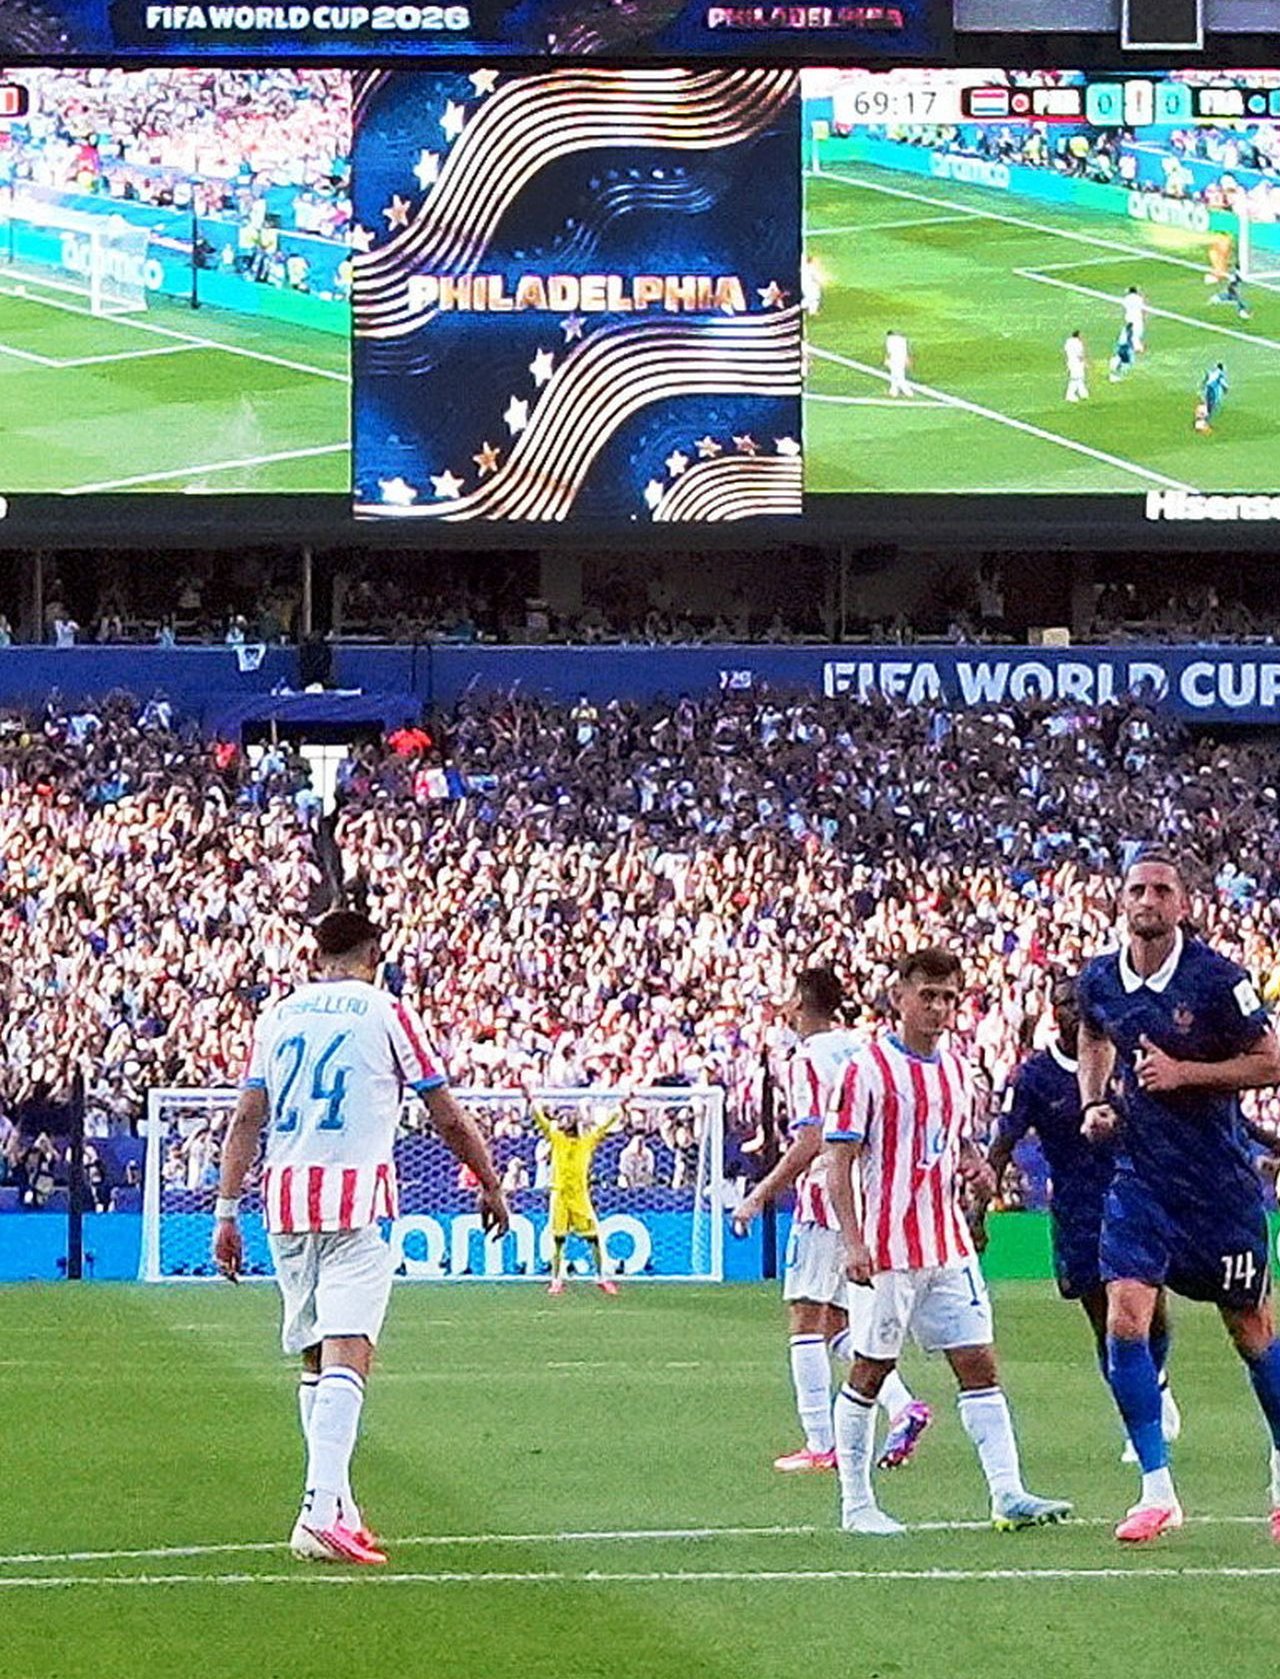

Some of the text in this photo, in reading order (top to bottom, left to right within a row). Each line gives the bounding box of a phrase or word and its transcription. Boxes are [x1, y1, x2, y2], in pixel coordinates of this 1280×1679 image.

[146, 6, 470, 31] FIFA WORLD CUP 2026
[854, 91, 937, 116] 69:17
[406, 274, 747, 314] PHILADELPHIA
[823, 661, 947, 705] FIFA
[956, 661, 1170, 707] WORLD
[275, 1029, 354, 1133] 24
[1221, 1250, 1257, 1291] 14
